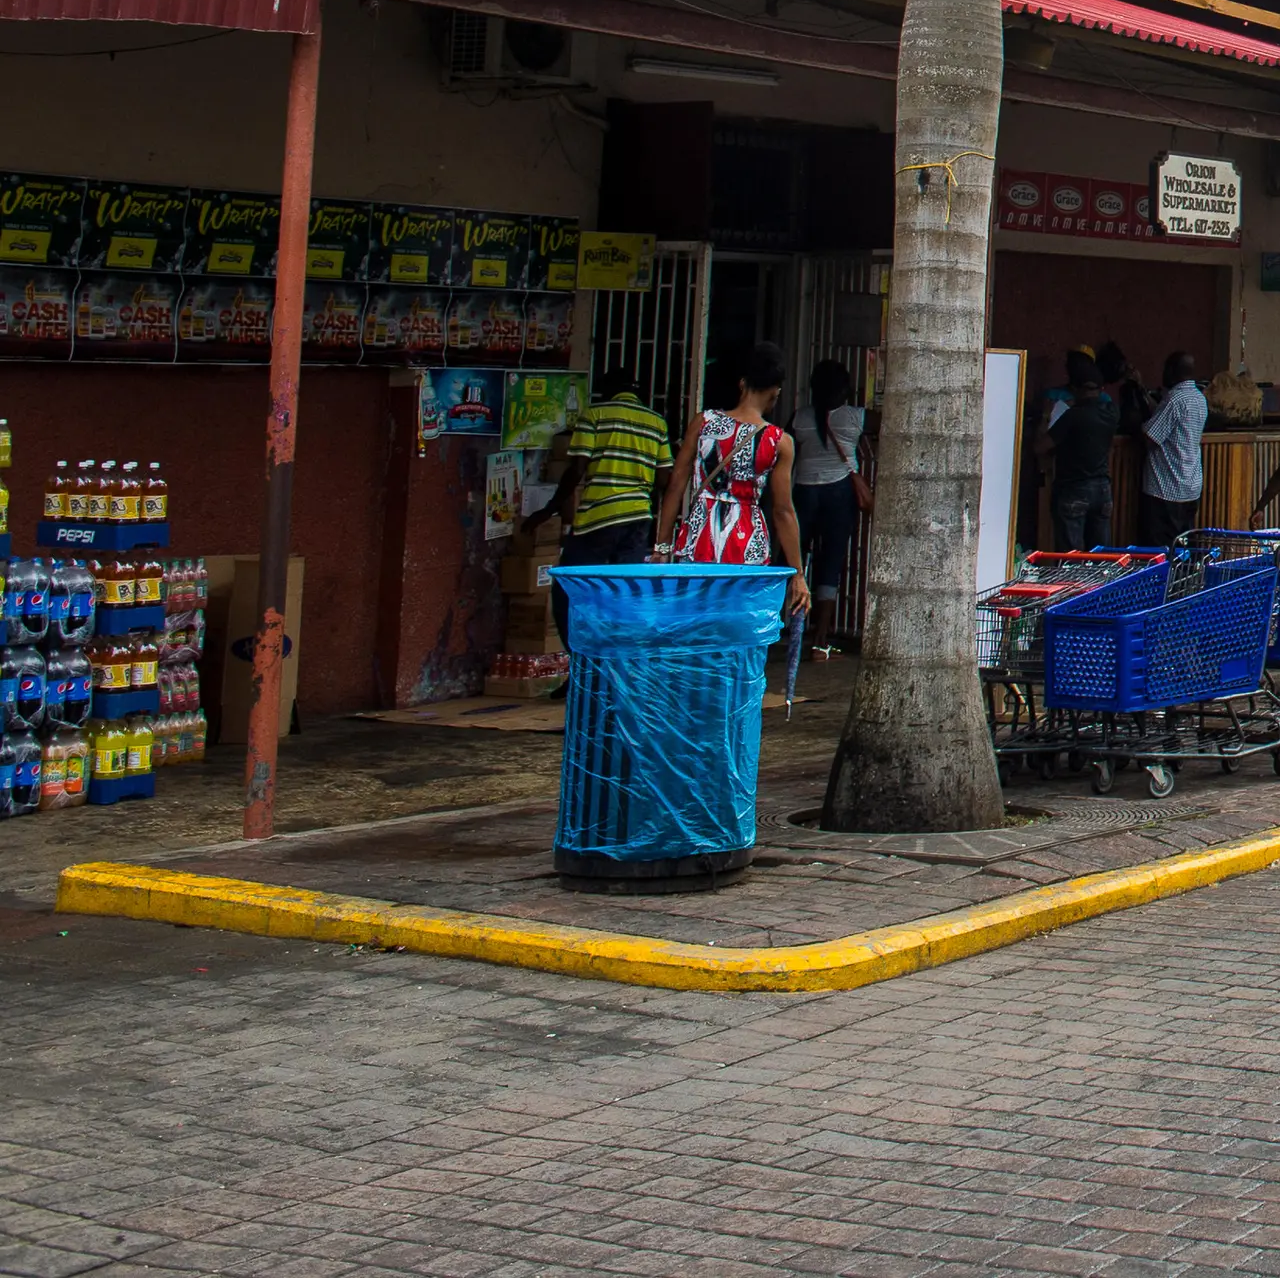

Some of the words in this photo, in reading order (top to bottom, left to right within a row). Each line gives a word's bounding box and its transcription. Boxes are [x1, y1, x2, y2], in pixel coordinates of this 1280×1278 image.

[1186, 162, 1216, 180] ORION
[1164, 175, 1226, 198] WHOLESALE
[1227, 183, 1236, 198] &
[1010, 189, 1037, 201] Grace
[1056, 194, 1080, 206] Grace
[1098, 198, 1121, 210] Grace
[1163, 193, 1237, 214] SUPERMARKET
[1169, 216, 1193, 232] TEL:
[56, 528, 96, 544] PEPSI
